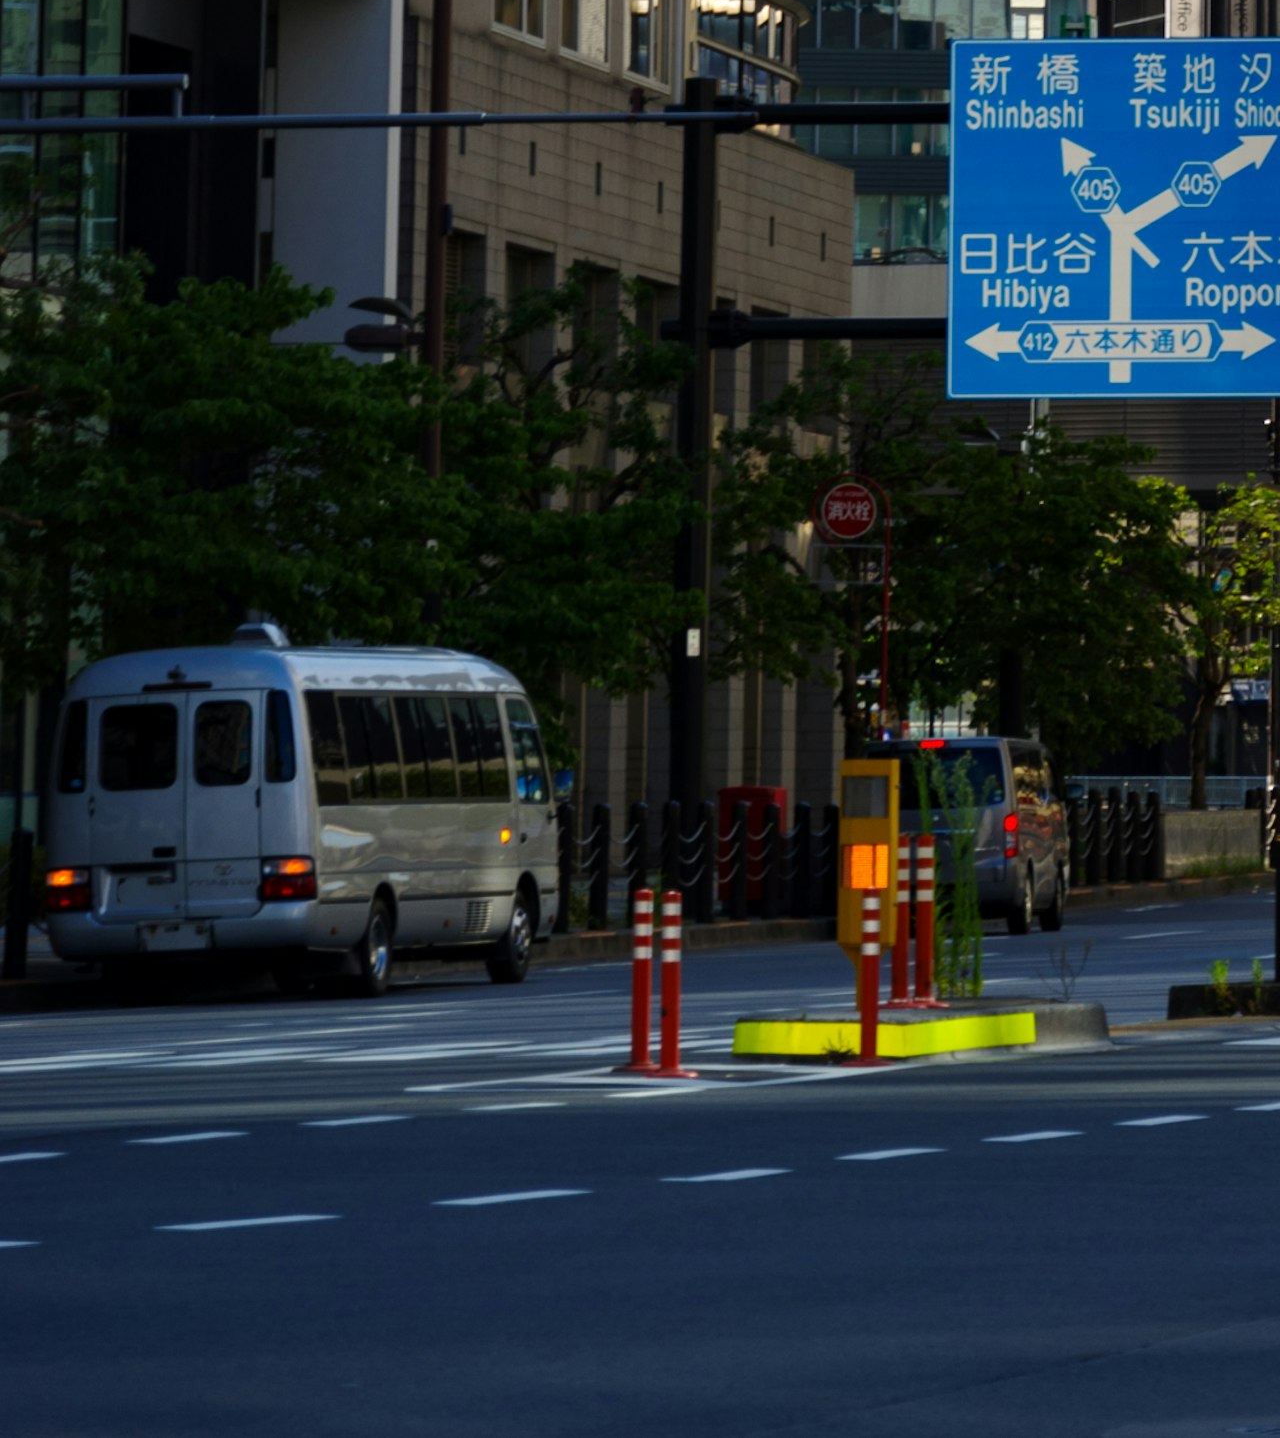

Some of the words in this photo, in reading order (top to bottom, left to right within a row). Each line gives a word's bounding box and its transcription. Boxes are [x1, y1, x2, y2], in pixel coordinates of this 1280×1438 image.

[969, 53, 1080, 96] 新橋
[1133, 52, 1217, 94] 築地
[966, 99, 1084, 130] Shinbashi
[1129, 98, 1220, 134] Tsukiji
[1078, 179, 1114, 201] 405
[1178, 173, 1215, 196] 405
[960, 233, 1097, 274] 日比谷
[982, 278, 1070, 314] Hibiya
[1023, 333, 1053, 352] 412
[1064, 328, 1203, 355] 六本木通り
[827, 500, 871, 521] 消火栓
